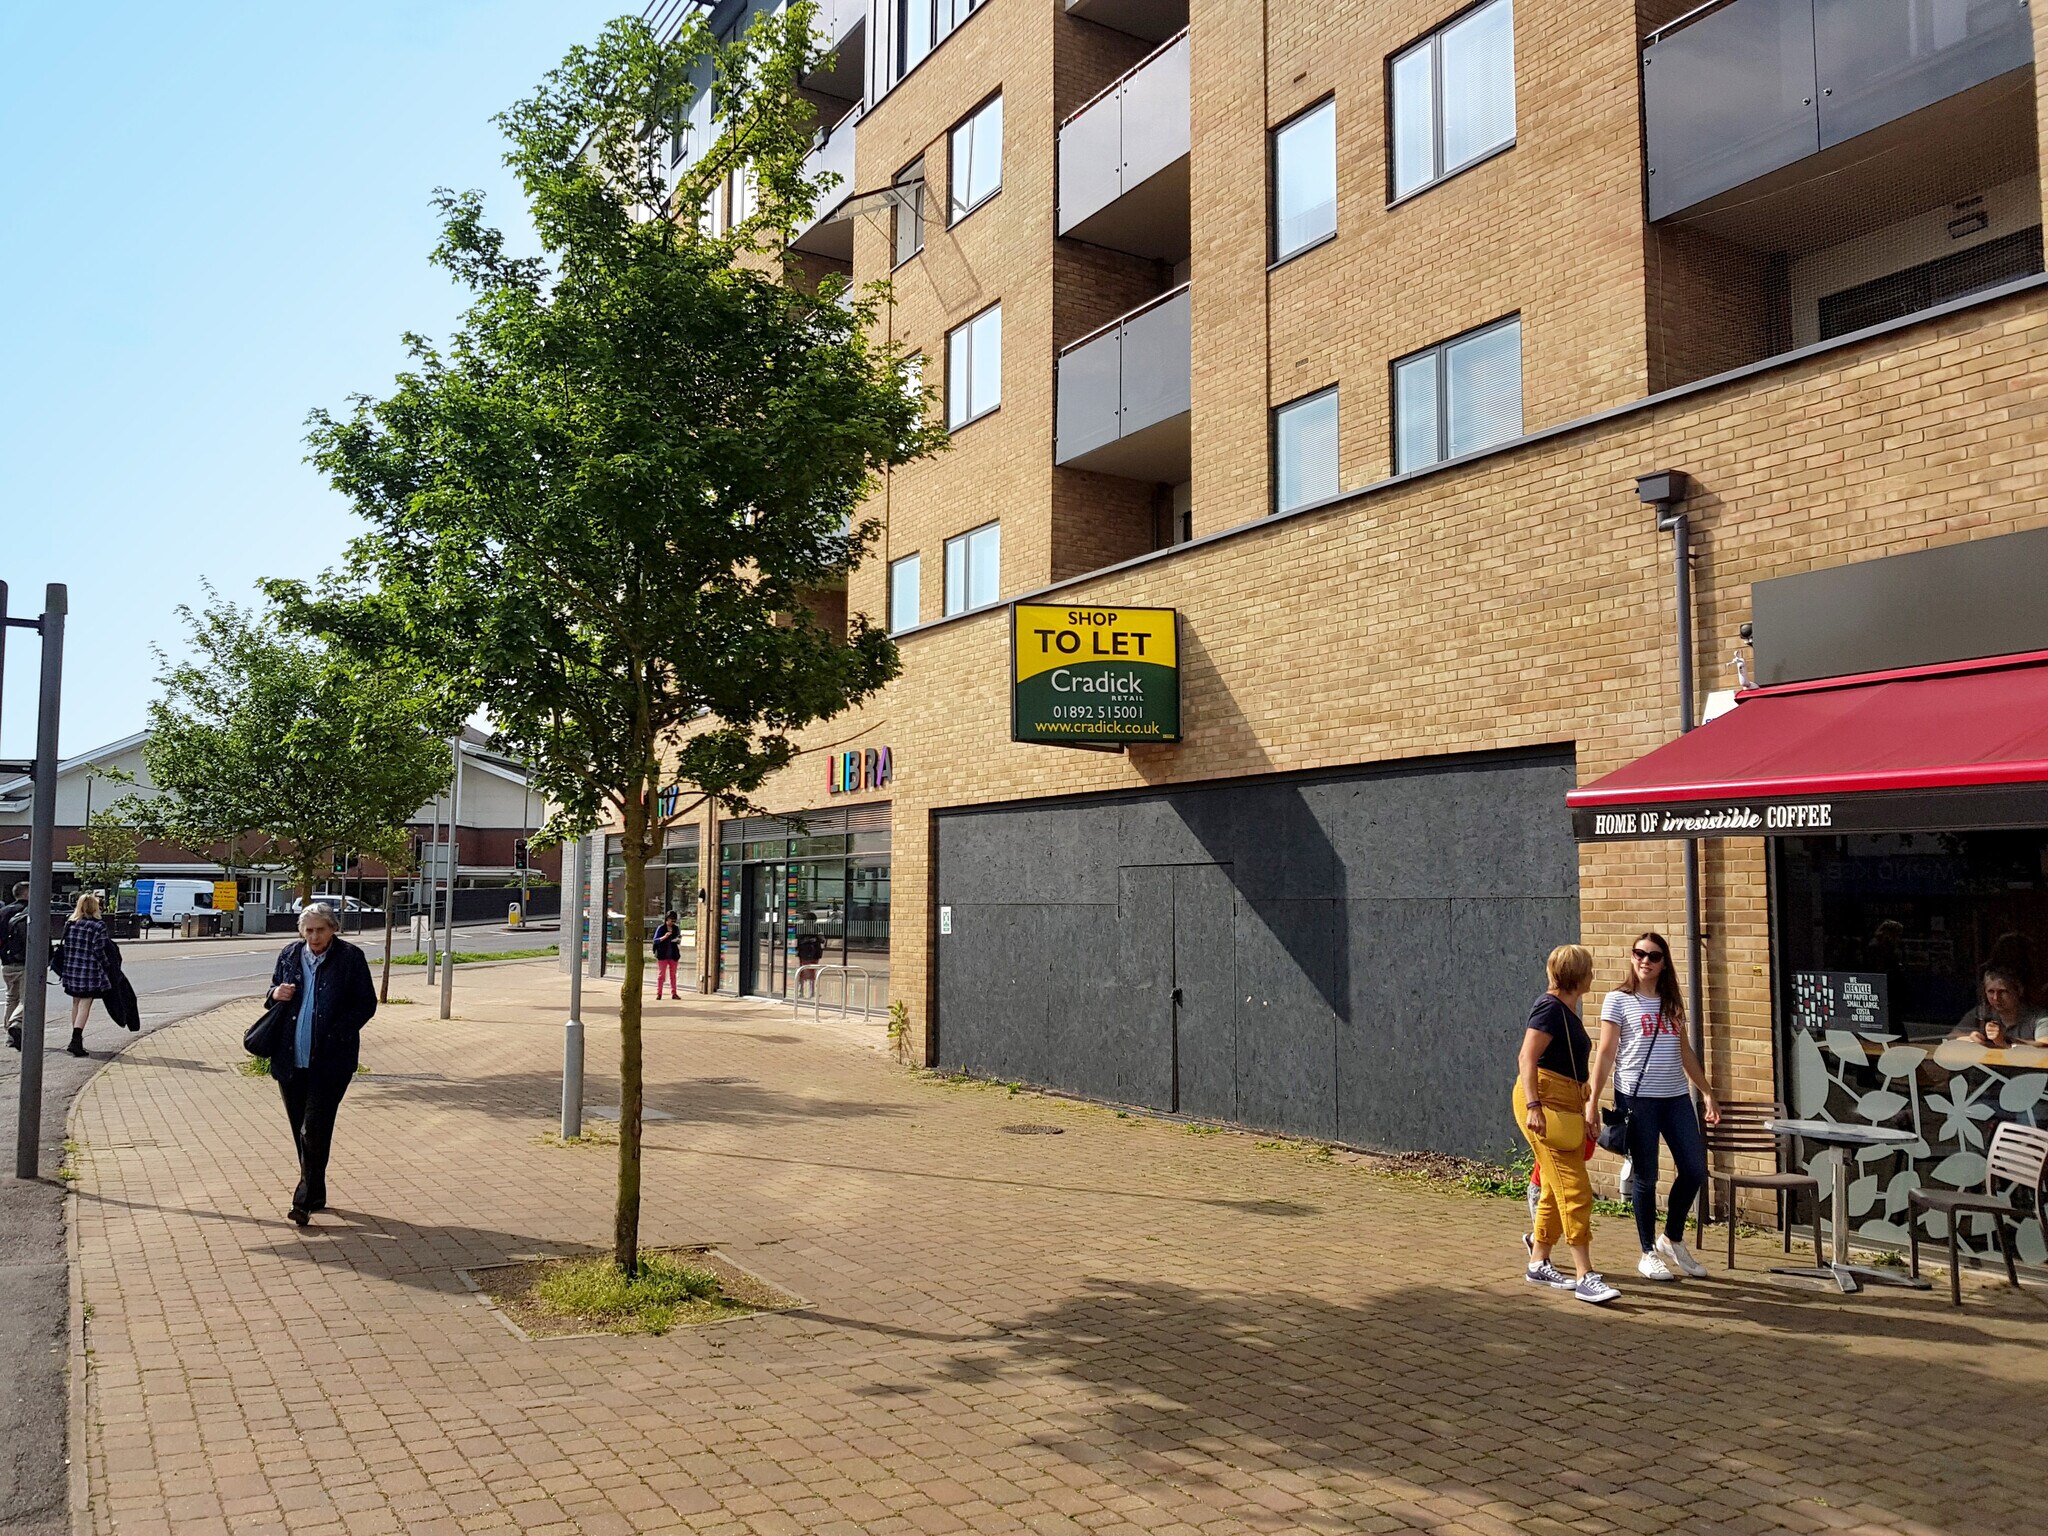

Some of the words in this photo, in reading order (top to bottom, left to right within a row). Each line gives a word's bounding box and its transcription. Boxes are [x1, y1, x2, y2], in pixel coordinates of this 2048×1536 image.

[1068, 611, 1118, 626] SHOP
[1034, 629, 1081, 654] TO
[1092, 631, 1152, 656] LET
[1051, 669, 1144, 694] Cradick
[1053, 705, 1094, 719] 01892
[1098, 706, 1143, 719] 515001
[1035, 720, 1160, 735] www.cradick.co.uk
[826, 745, 893, 794] LIBRA
[1594, 813, 1637, 835] HOME
[1640, 812, 1660, 834] OF
[1662, 807, 1762, 832] irresistible
[1767, 804, 1832, 829] COFFEE
[152, 882, 166, 916] Initial
[1845, 983, 1871, 994] RECYCLE
